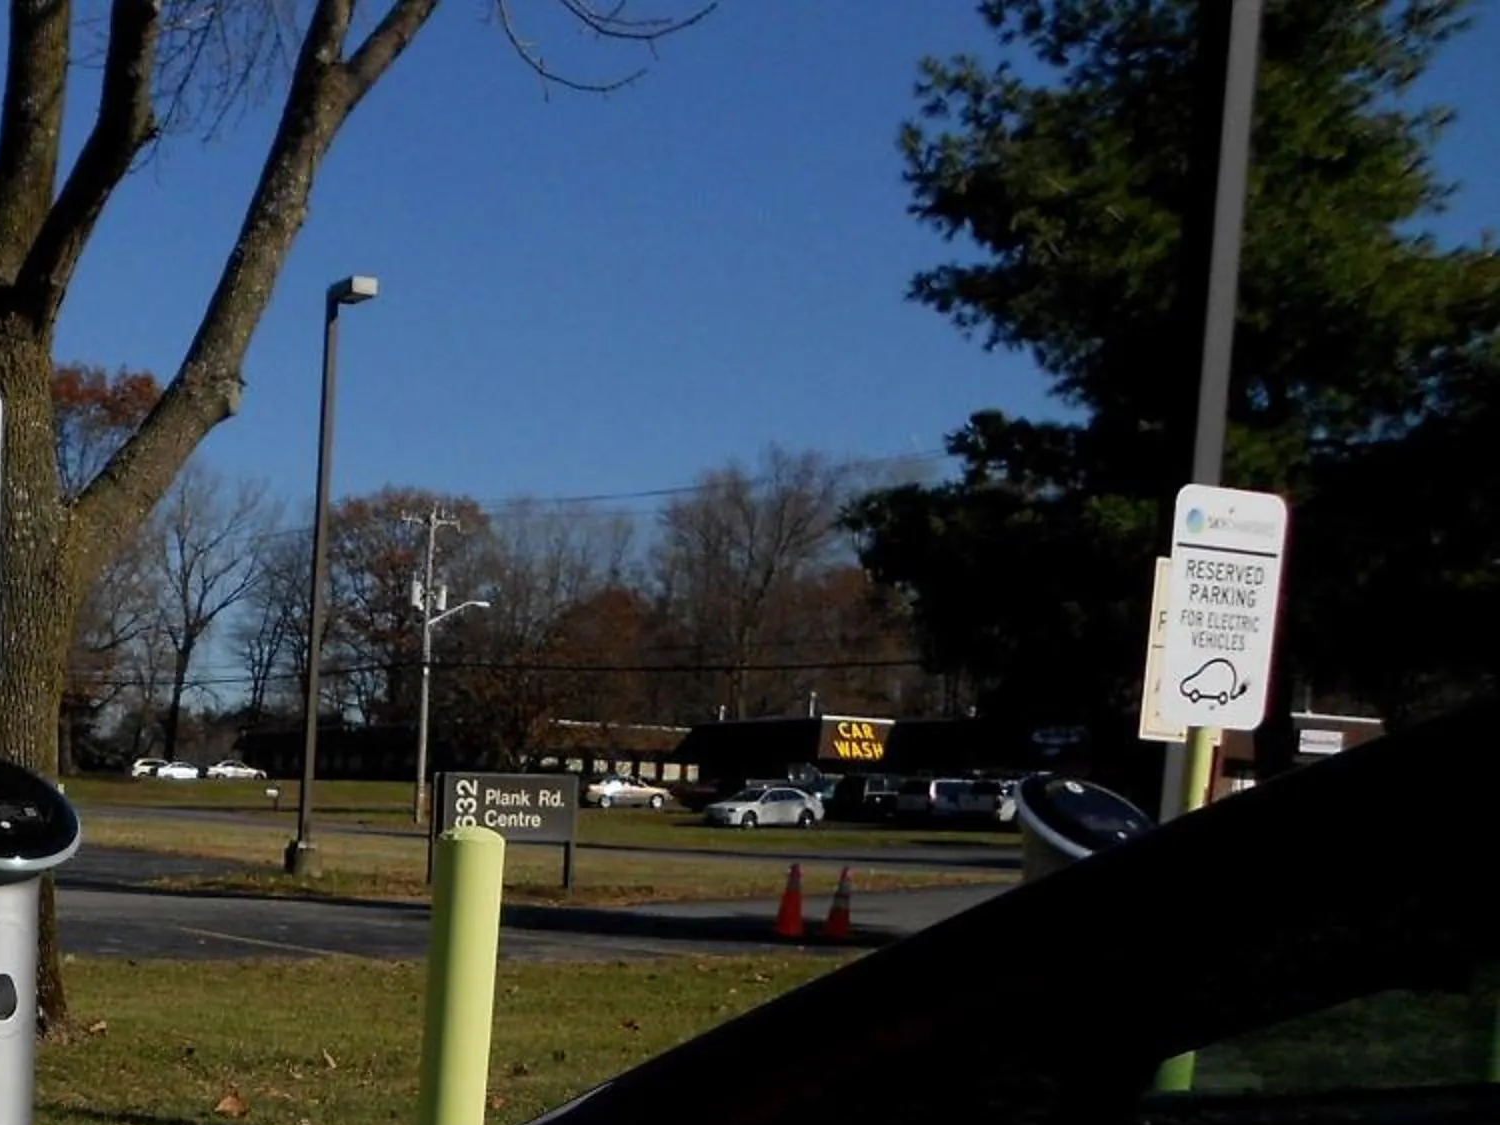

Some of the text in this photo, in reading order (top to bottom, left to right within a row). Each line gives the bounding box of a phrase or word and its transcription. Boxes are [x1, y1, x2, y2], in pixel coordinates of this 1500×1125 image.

[1185, 559, 1265, 585] RESERVED
[1189, 584, 1256, 608] PARKING
[1180, 609, 1203, 627] FOR
[1208, 612, 1260, 632] ELECTRIC
[1191, 631, 1246, 651] VEHICLES
[837, 722, 874, 739] CAR
[833, 740, 884, 760] WASH
[485, 788, 565, 807] Plank Rd.
[484, 809, 541, 827] Centre
